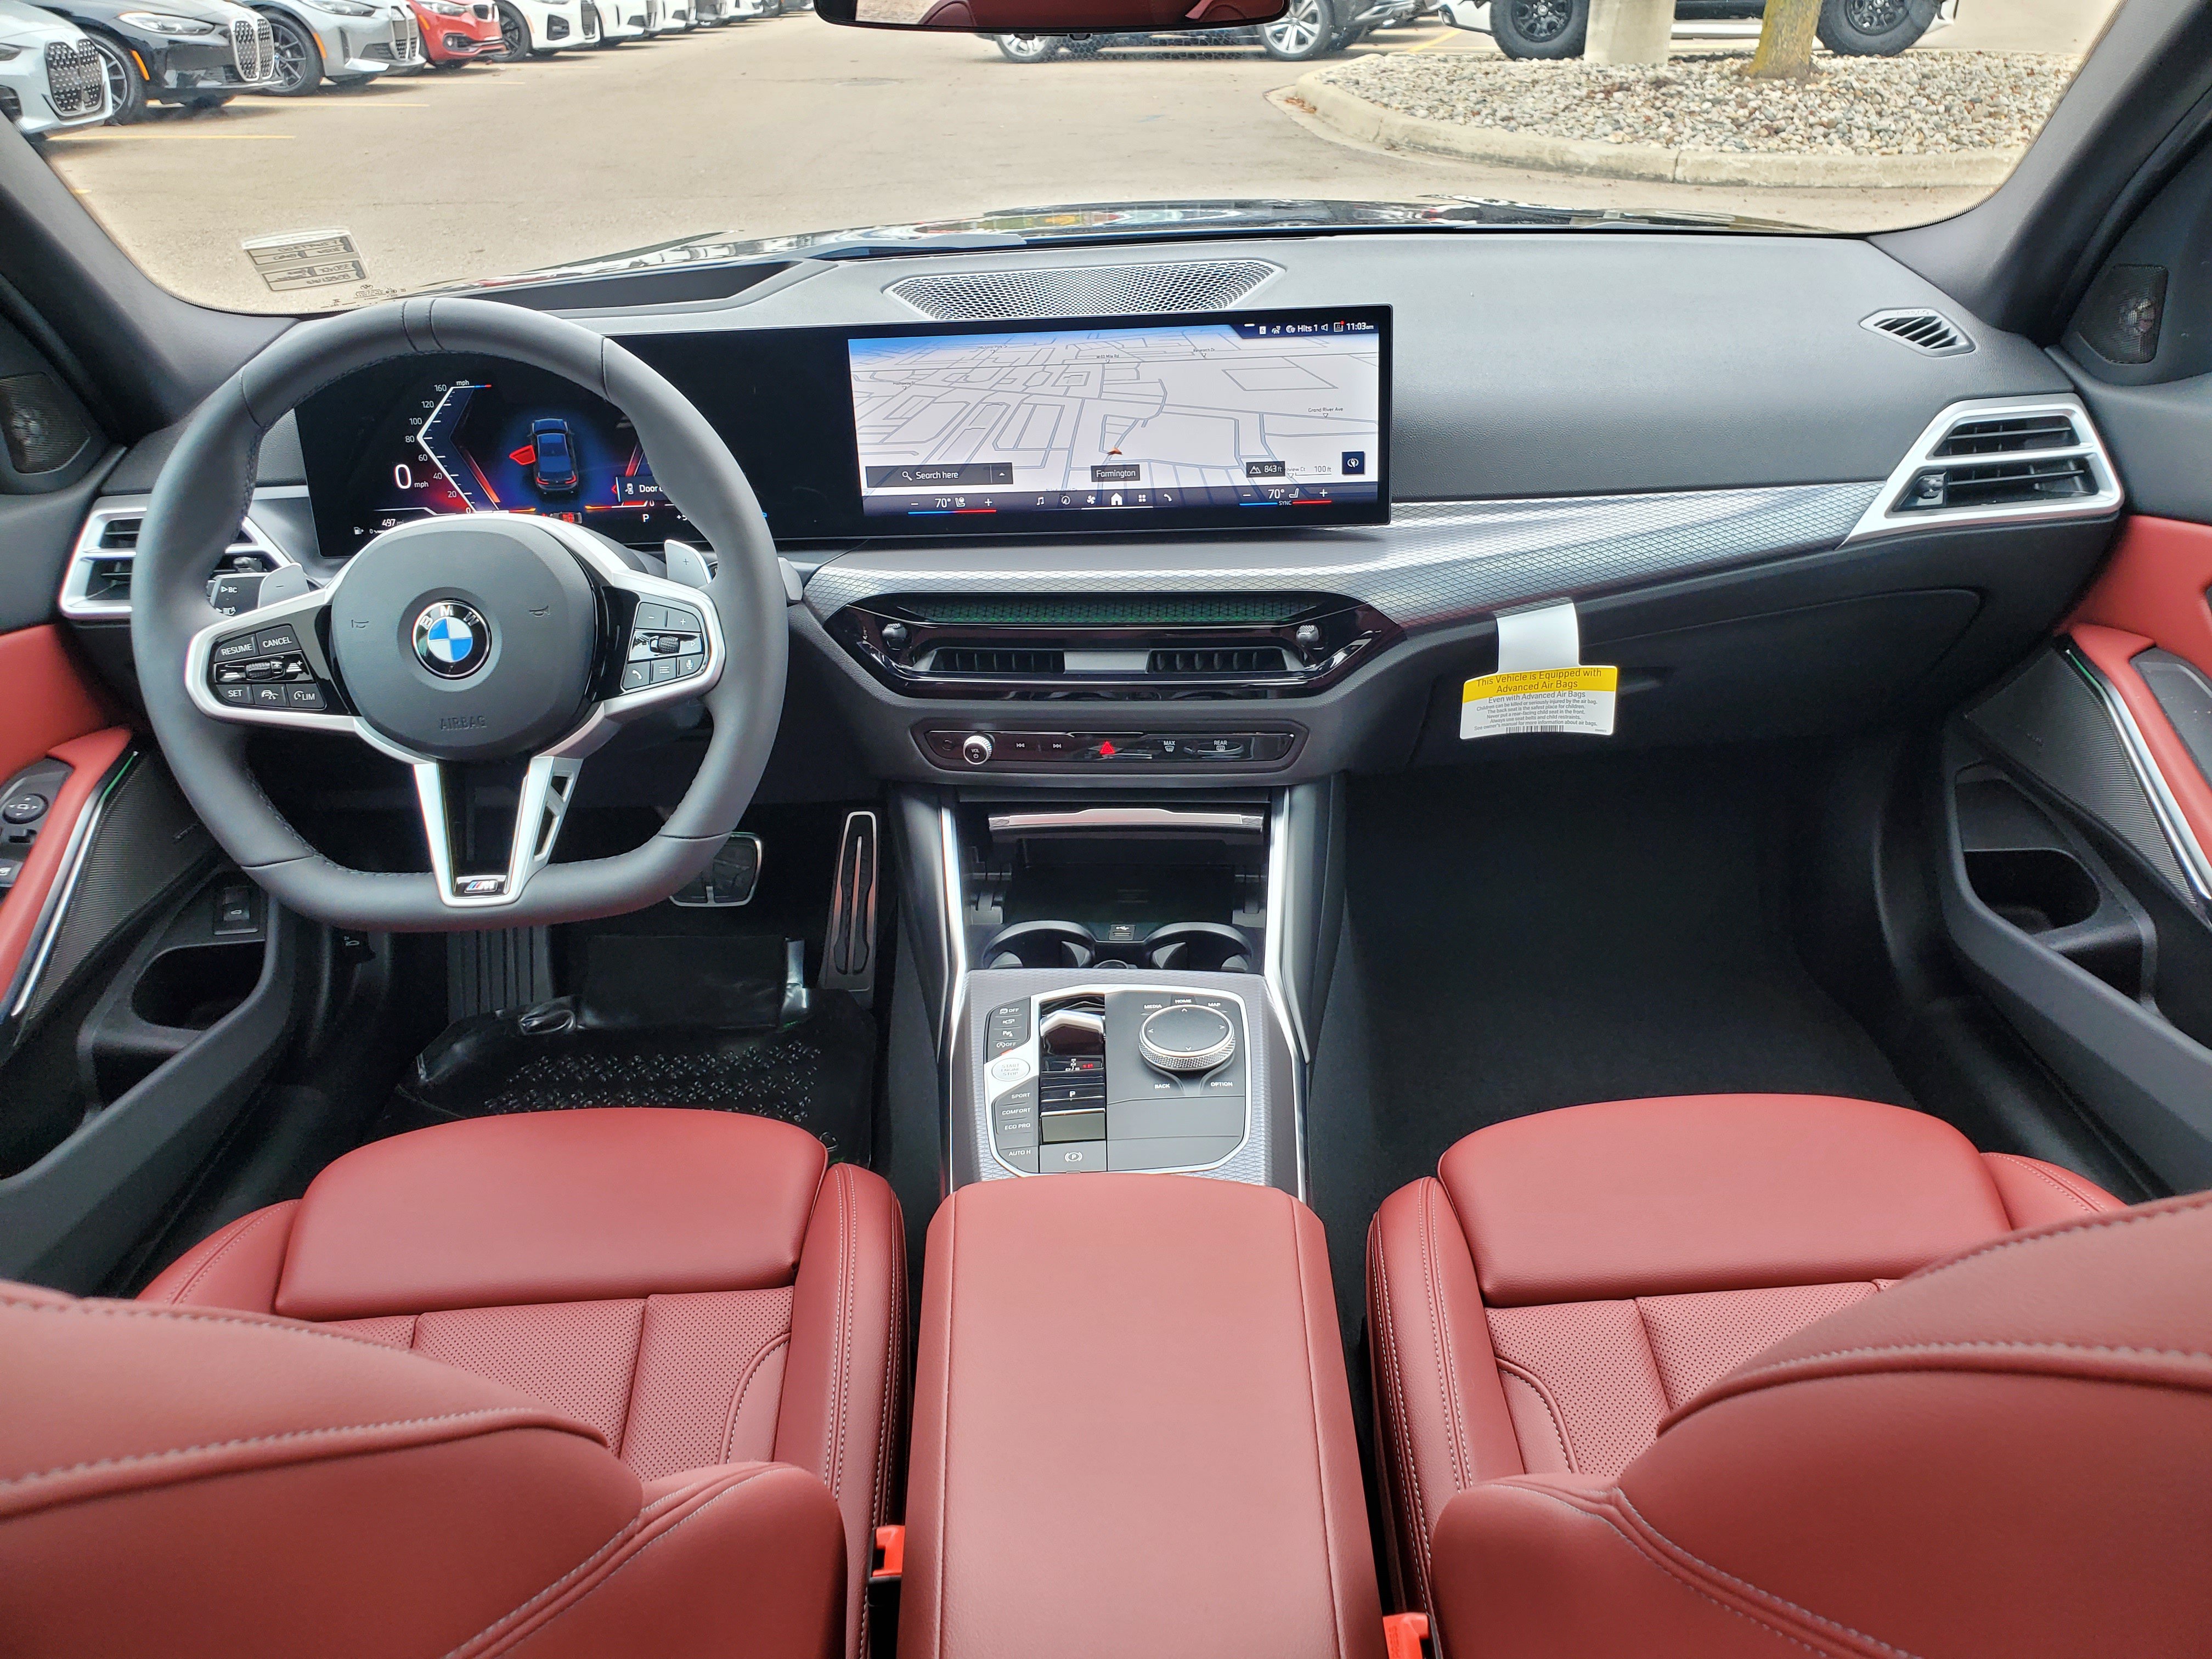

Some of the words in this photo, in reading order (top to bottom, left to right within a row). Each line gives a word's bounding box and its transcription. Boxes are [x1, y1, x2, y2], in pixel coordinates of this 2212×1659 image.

[1096, 470, 1136, 478] Farmington
[1264, 465, 1277, 473] 843
[394, 464, 412, 489] 0
[916, 471, 941, 481] Search
[941, 470, 959, 479] here
[414, 481, 429, 489] mph
[639, 484, 658, 493] Door
[1268, 489, 1285, 499] 70°
[935, 498, 951, 508] 70°
[382, 518, 396, 527] 497
[642, 514, 650, 522] P
[420, 605, 479, 630] BMW
[263, 636, 292, 648] CANCEL
[221, 643, 253, 656] RESUME
[1476, 679, 1493, 687] This
[1496, 674, 1527, 684] Vehicle
[1539, 668, 1581, 682] Equipped
[1583, 668, 1601, 678] with
[1497, 681, 1539, 693] Advanced
[1541, 681, 1554, 690] Air
[1556, 680, 1578, 691] Bags
[228, 689, 242, 697] SET
[1521, 691, 1555, 700] Advanced
[440, 715, 487, 731] AIRBAG
[1002, 1107, 1031, 1115] COMFORT
